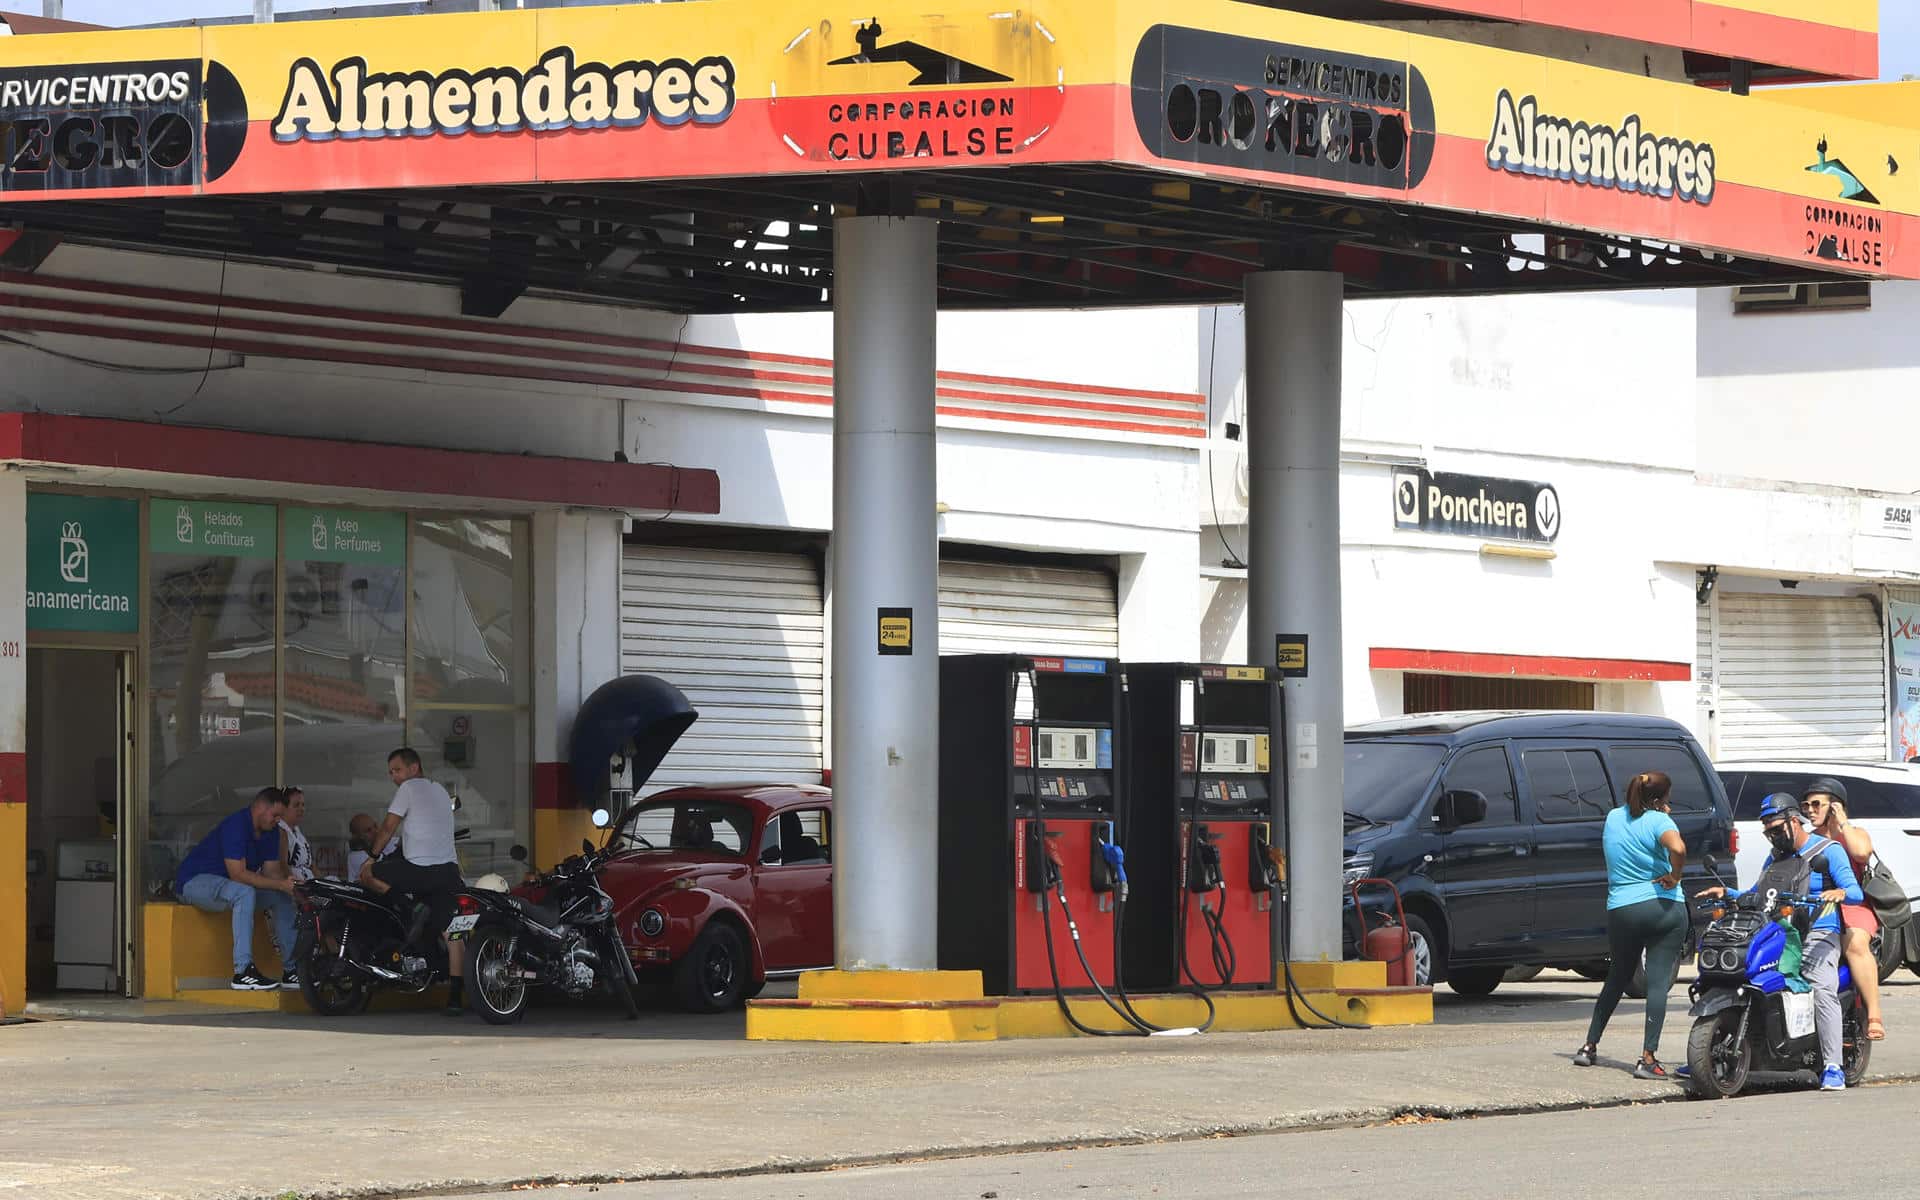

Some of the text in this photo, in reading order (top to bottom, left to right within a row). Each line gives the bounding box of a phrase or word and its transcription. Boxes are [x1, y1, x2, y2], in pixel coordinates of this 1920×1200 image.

[0, 70, 190, 108] RVICENTROS
[1263, 53, 1402, 103] SERVICENTROS
[273, 48, 736, 141] Almendares
[828, 97, 1015, 124] CORPORACION
[0, 112, 194, 173] EGRO
[1167, 83, 1409, 171] ORO NEGRO
[828, 126, 1015, 162] CUBALSE
[1486, 89, 1716, 205] Almendares
[1805, 205, 1881, 233] CORPORACION
[203, 510, 244, 528] Helados
[1427, 485, 1528, 529] Ponchera
[1884, 506, 1912, 524] SASA
[204, 529, 255, 548] Confituras
[334, 516, 359, 533] Aseo
[334, 534, 382, 552] Perfumes
[27, 587, 130, 613] anamericana
